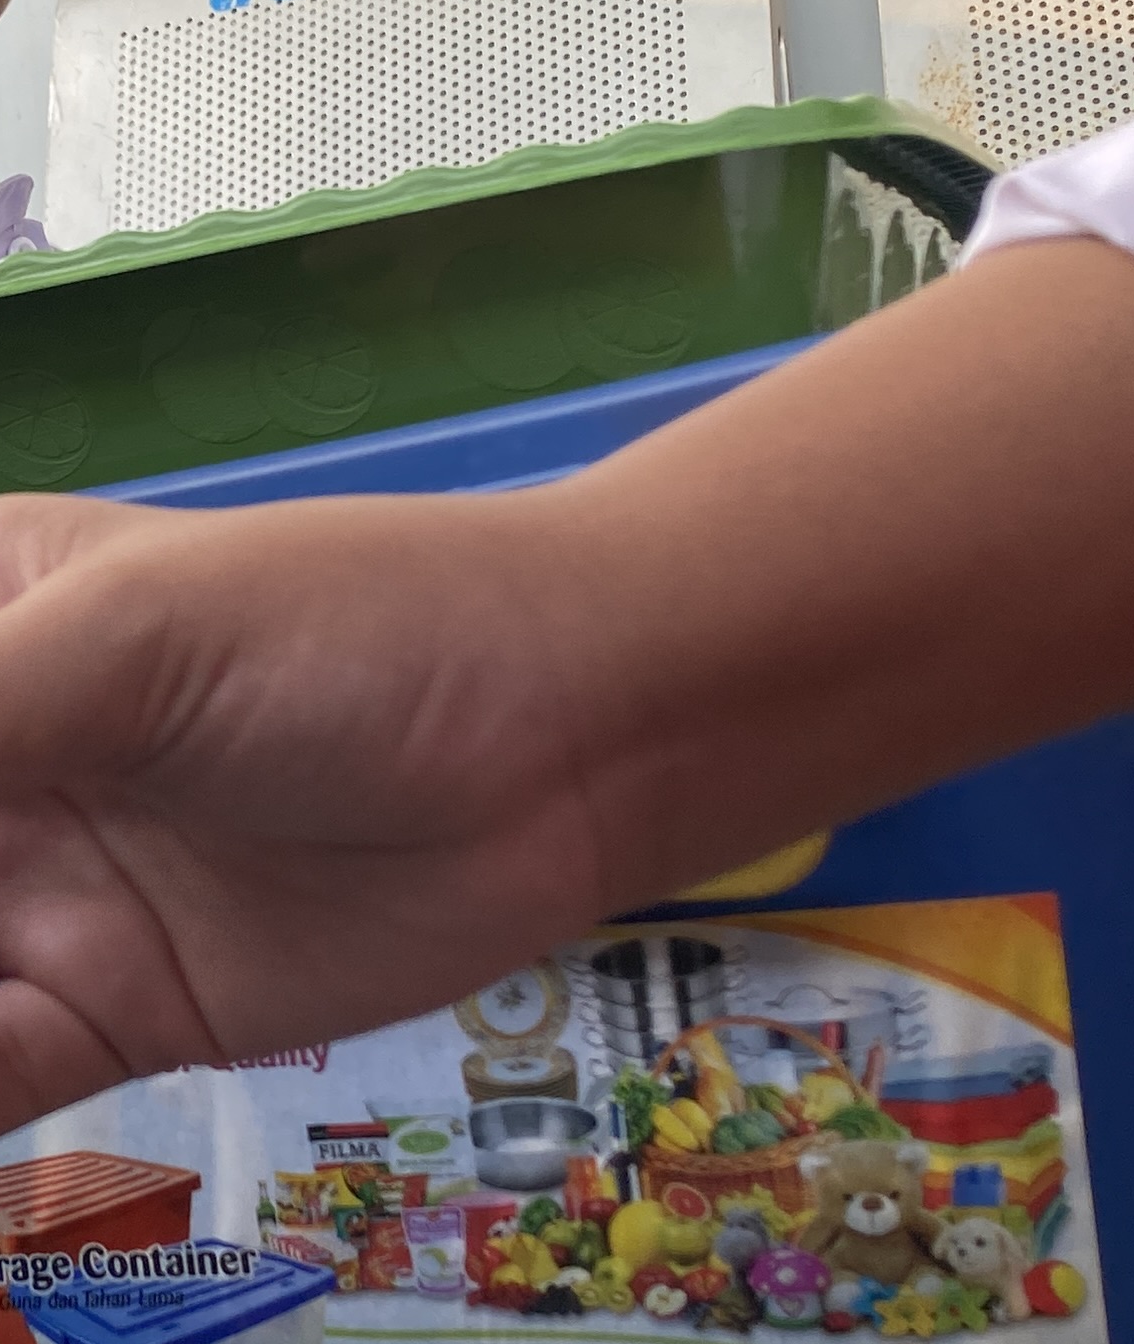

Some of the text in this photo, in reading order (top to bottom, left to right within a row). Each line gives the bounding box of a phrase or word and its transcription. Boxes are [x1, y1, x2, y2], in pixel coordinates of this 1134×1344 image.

[319, 1143, 381, 1159] FILMA
[83, 1244, 258, 1279] Container
[48, 1290, 78, 1310] dan
[84, 1287, 132, 1309] Tahan
[139, 1289, 184, 1307] Lama
